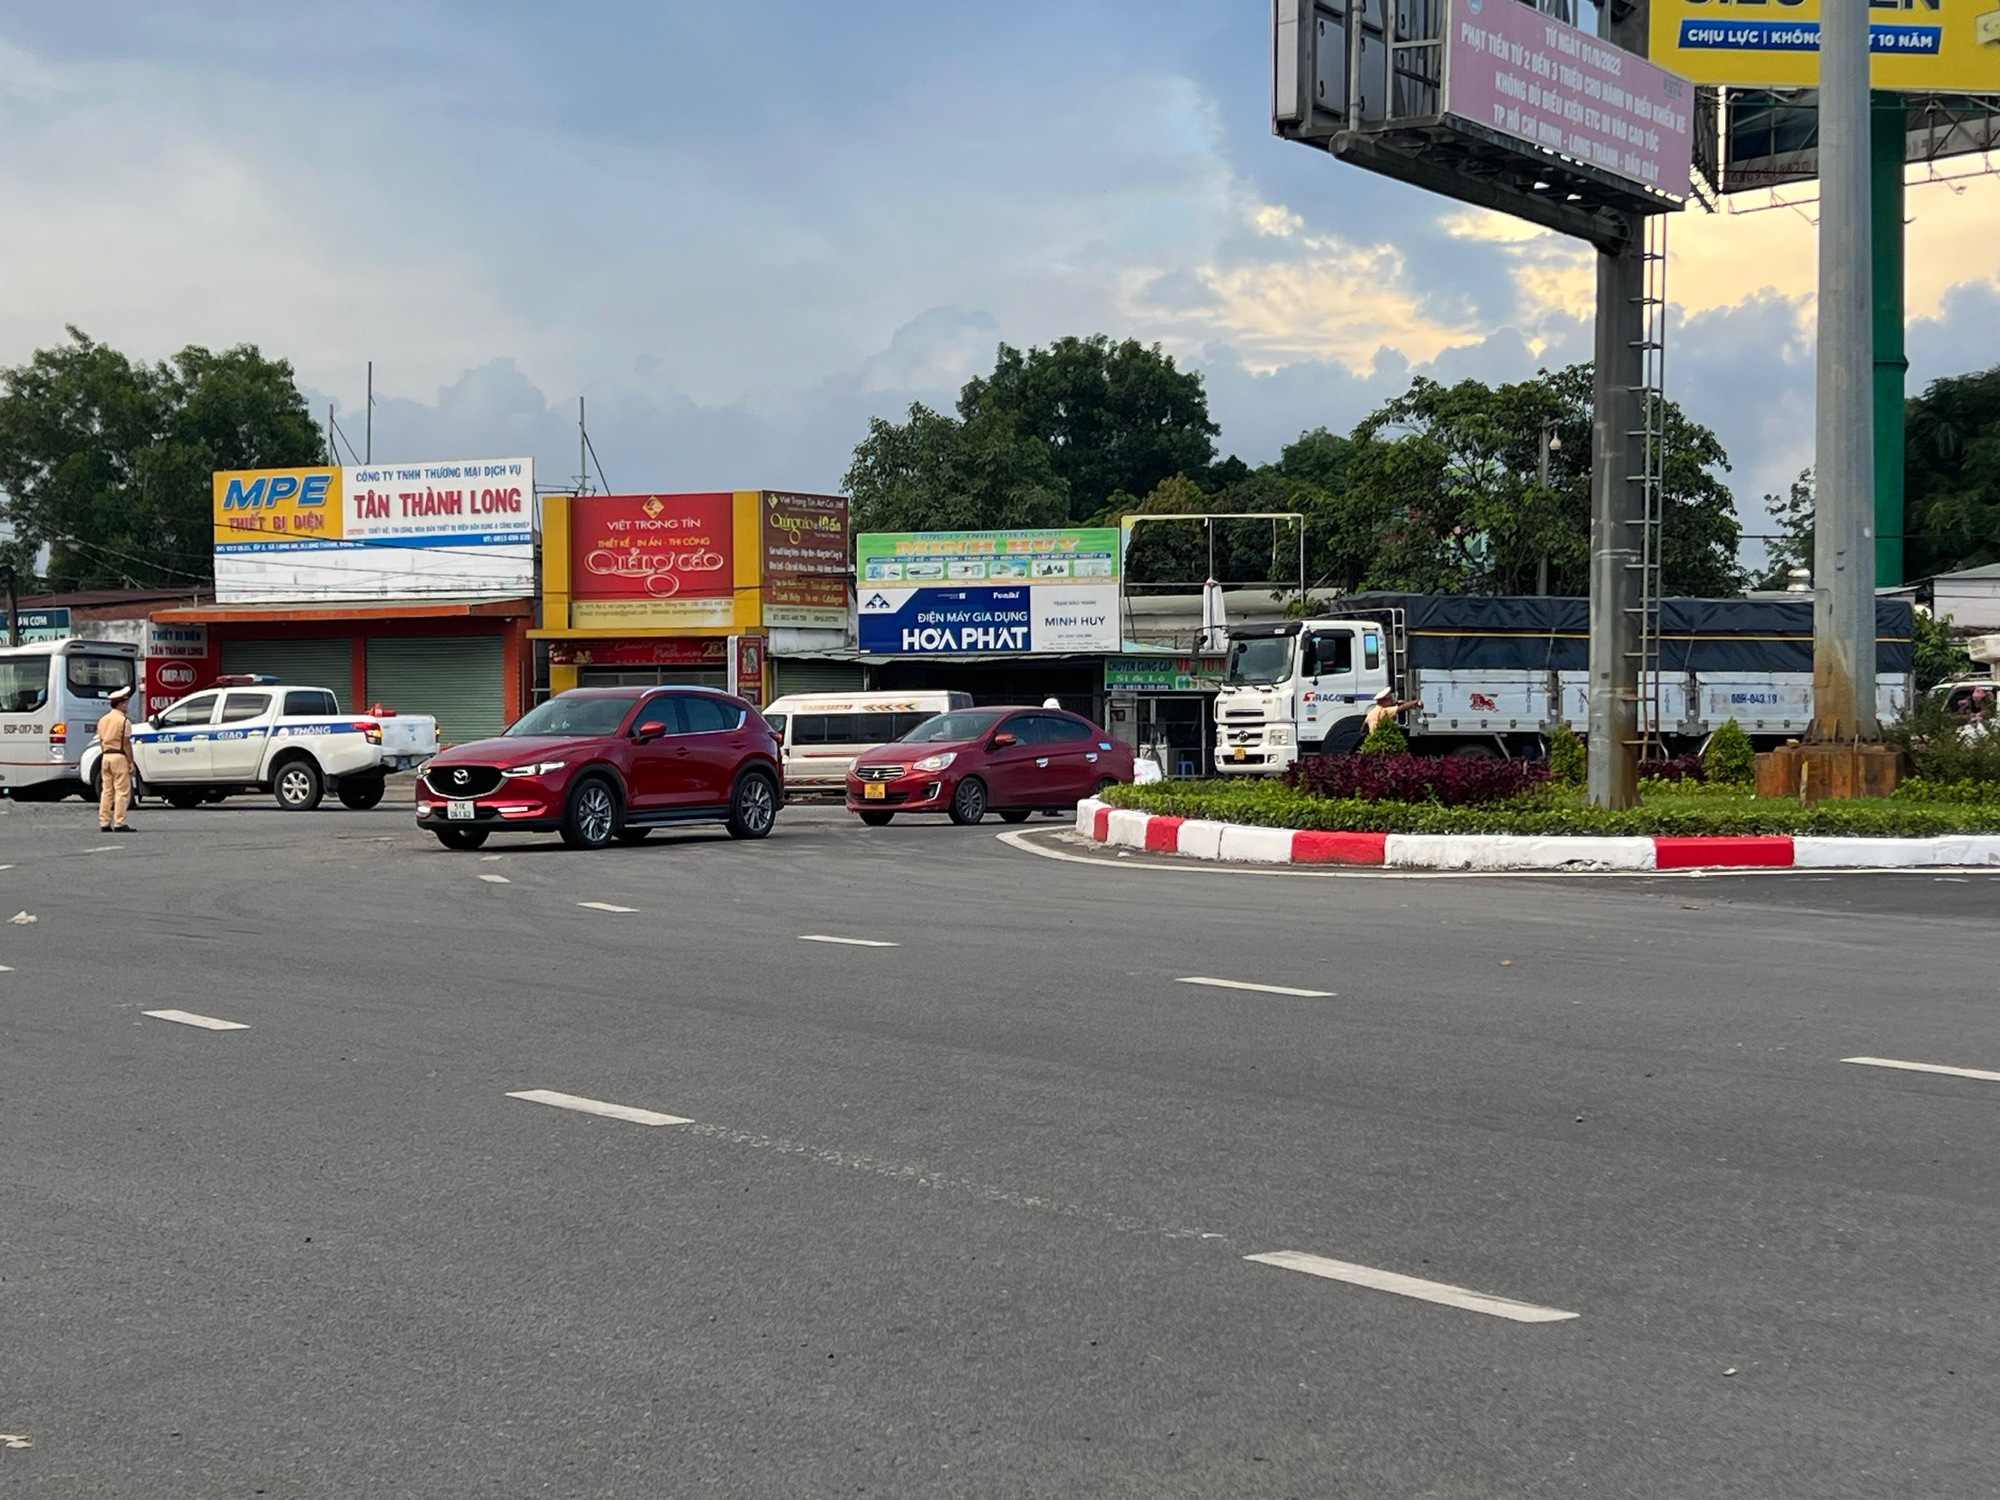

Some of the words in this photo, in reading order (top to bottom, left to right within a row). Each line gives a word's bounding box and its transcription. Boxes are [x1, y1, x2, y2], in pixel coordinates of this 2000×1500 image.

[1687, 29, 1724, 45] CHỊU
[1728, 29, 1759, 46] LỰC
[1878, 34, 1895, 47] 10
[1898, 32, 1933, 48] NĂM
[1461, 22, 1486, 53] PHẠT
[1523, 50, 1530, 71] 2
[1551, 62, 1558, 81] 3
[1585, 107, 1600, 131] ETC
[356, 470, 380, 482] CÔNG
[383, 471, 394, 482] TY
[396, 469, 421, 480] TNHH
[425, 466, 461, 478] THƯƠNG
[464, 467, 481, 480] MẠI
[485, 465, 506, 478] DỊCH
[509, 464, 521, 477] VỤ
[223, 476, 332, 509] MPE
[353, 489, 390, 518] TÂN
[399, 486, 462, 517] THÀNH
[470, 487, 521, 514] LONG
[228, 512, 267, 532] THIẾT
[273, 516, 286, 534] BỊ
[294, 511, 325, 533] ĐIỆN
[607, 518, 631, 531] VIỆT
[681, 517, 700, 528] TÍN
[597, 537, 619, 548] THIẾT
[620, 536, 631, 548] KẾ
[637, 539, 648, 547] IN
[648, 535, 662, 547] ẤN
[668, 538, 681, 546] THI
[683, 537, 710, 546] CÔNG
[895, 541, 996, 555] MINH
[1006, 537, 1080, 552] HUY
[676, 548, 724, 571] cáo
[917, 610, 944, 625] ĐIỆN
[947, 610, 971, 622] MÁY
[973, 612, 992, 622] GIA
[994, 611, 1028, 625] DỤNG
[1044, 617, 1077, 627] MINH
[1081, 616, 1105, 626] HUY
[961, 626, 1028, 650] PHÁT
[217, 731, 243, 740] GIAO
[293, 724, 331, 735] THÔNG
